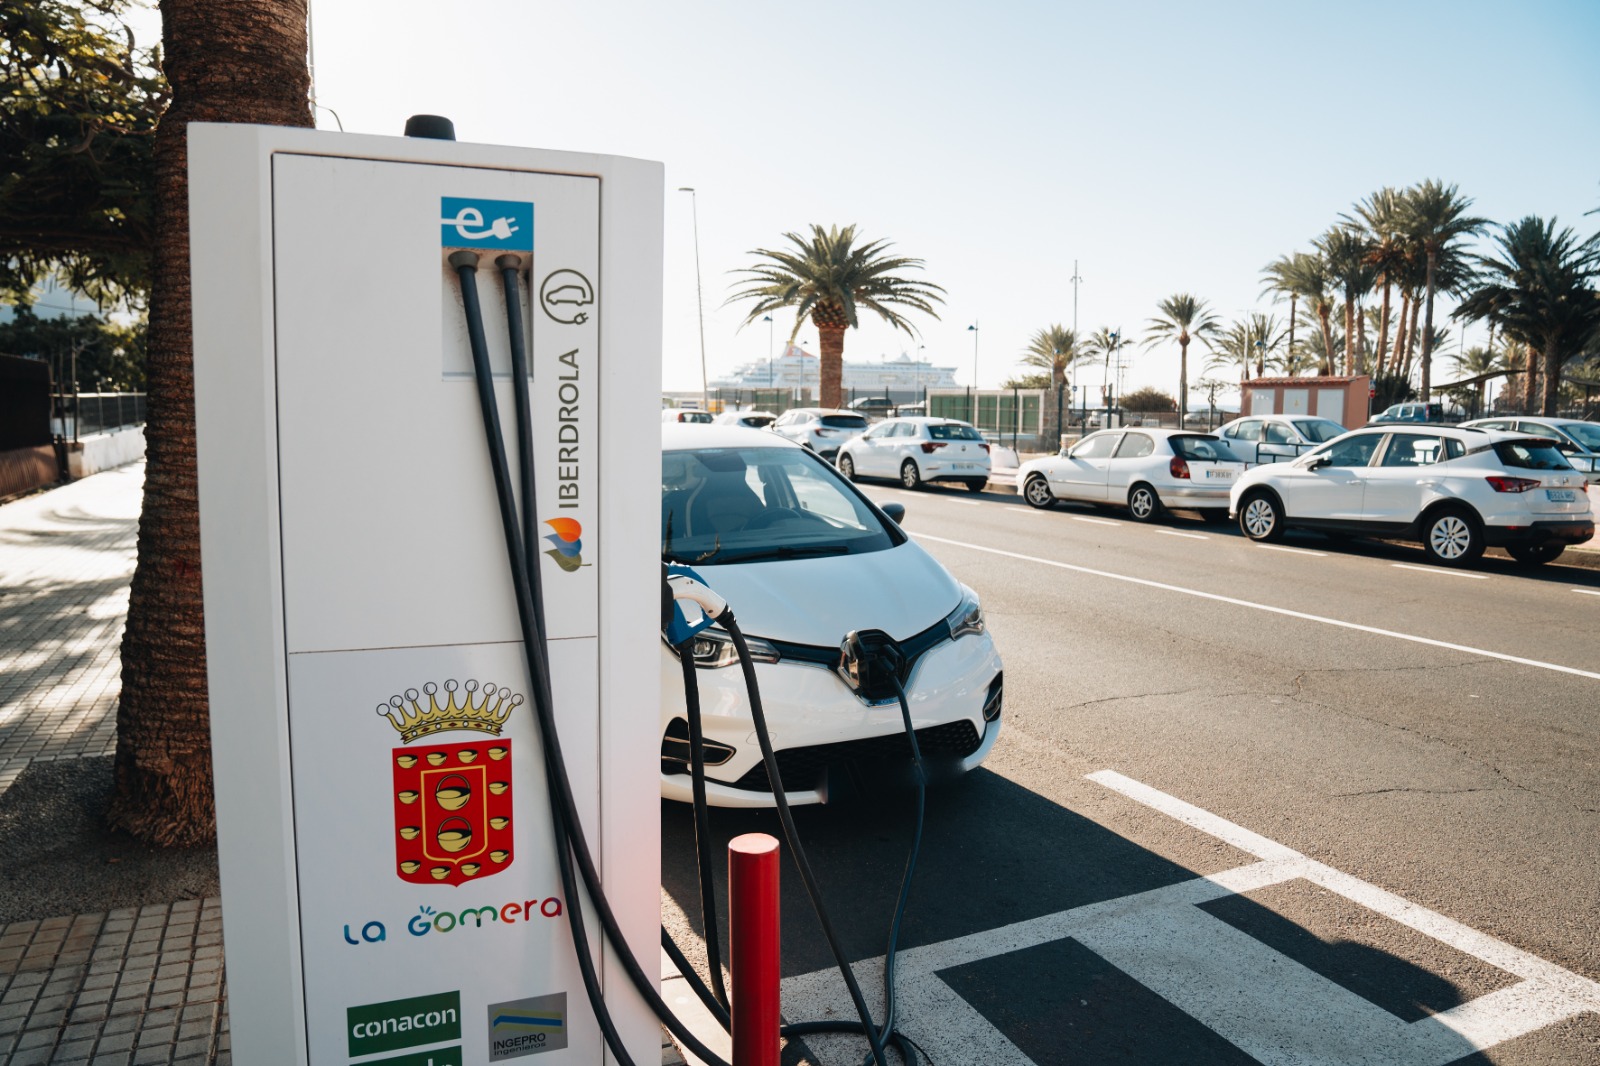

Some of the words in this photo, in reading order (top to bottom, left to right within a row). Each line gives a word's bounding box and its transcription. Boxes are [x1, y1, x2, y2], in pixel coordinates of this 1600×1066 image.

[558, 348, 579, 509] IBERDROLA
[407, 896, 563, 937] Gomera
[352, 1007, 457, 1039] conacon
[493, 1032, 546, 1051] INGEPRO
[494, 1041, 547, 1056] ingenieros
